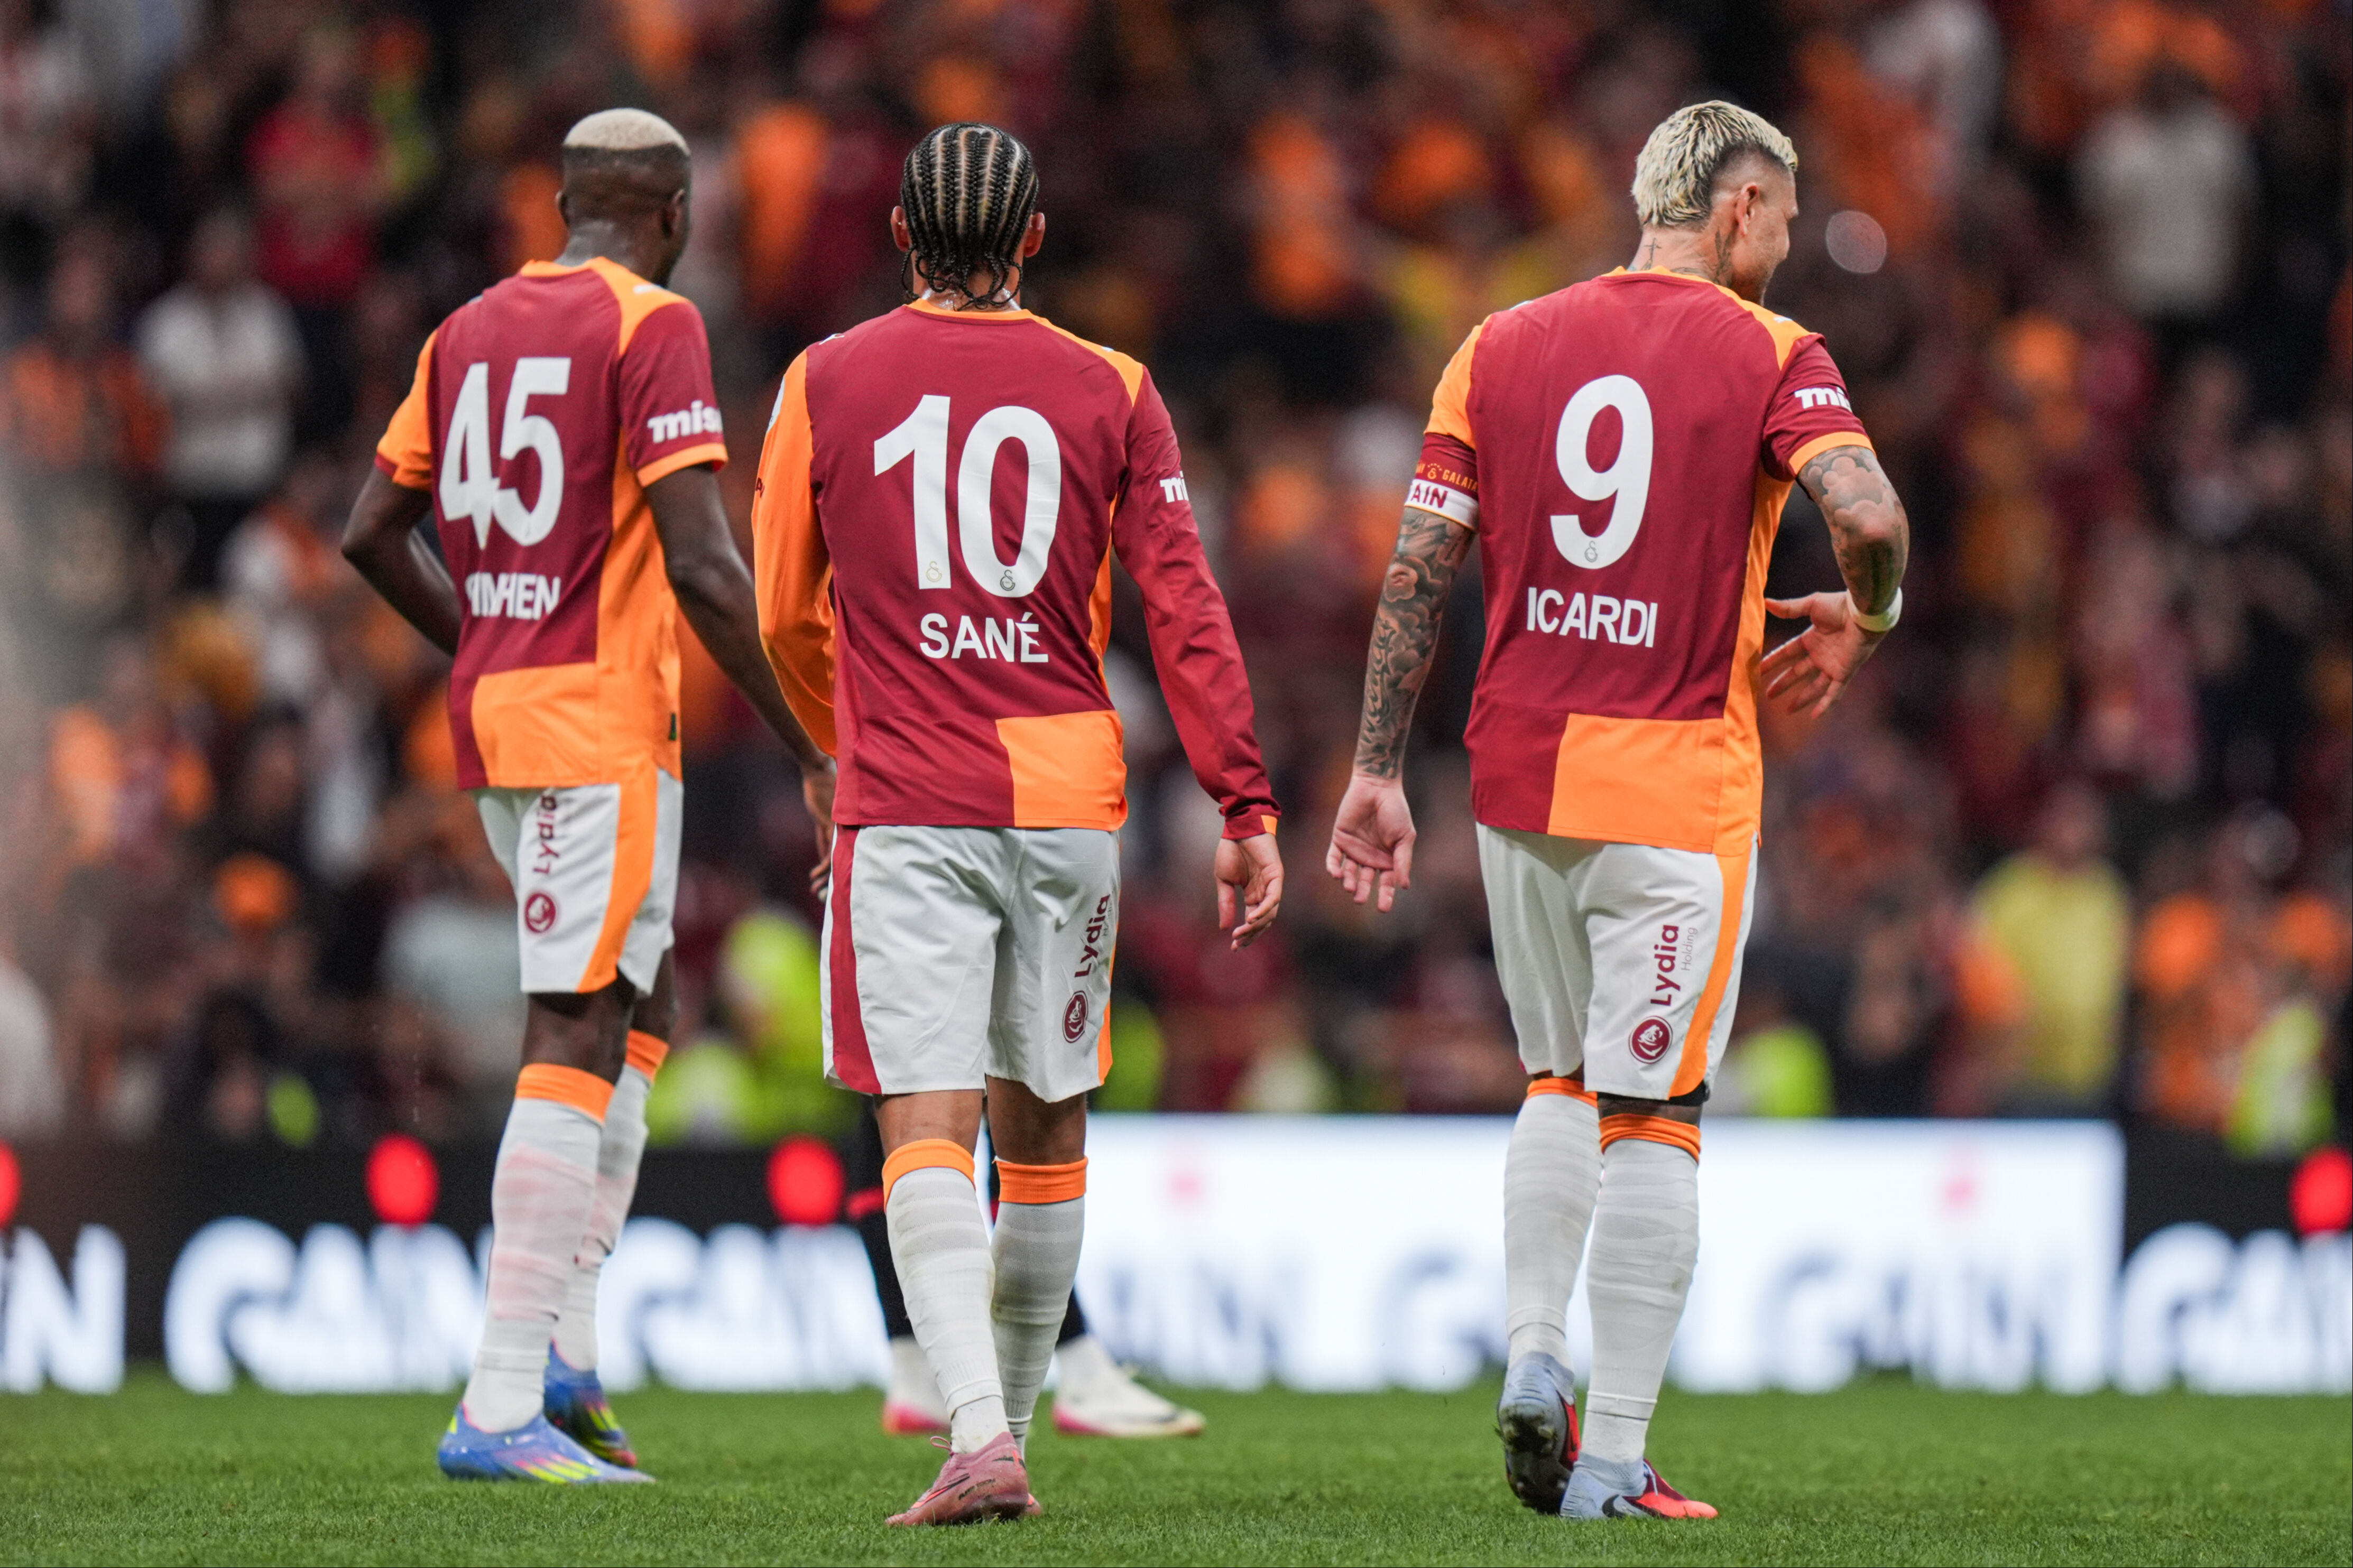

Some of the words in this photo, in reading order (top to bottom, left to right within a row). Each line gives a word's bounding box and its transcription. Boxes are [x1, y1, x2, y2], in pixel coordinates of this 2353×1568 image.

[1794, 386, 1852, 413] mi
[440, 357, 571, 549] 45
[1550, 374, 1654, 570] 9
[874, 394, 1062, 598] 10
[1410, 483, 1448, 508] AIN
[919, 611, 1049, 663] SANÉ
[1527, 587, 1658, 648] ICARDI
[532, 794, 559, 874] Lydia
[1074, 894, 1111, 978] Lydia
[1650, 924, 1681, 1006] Lydia
[1681, 926, 1698, 971] Holding
